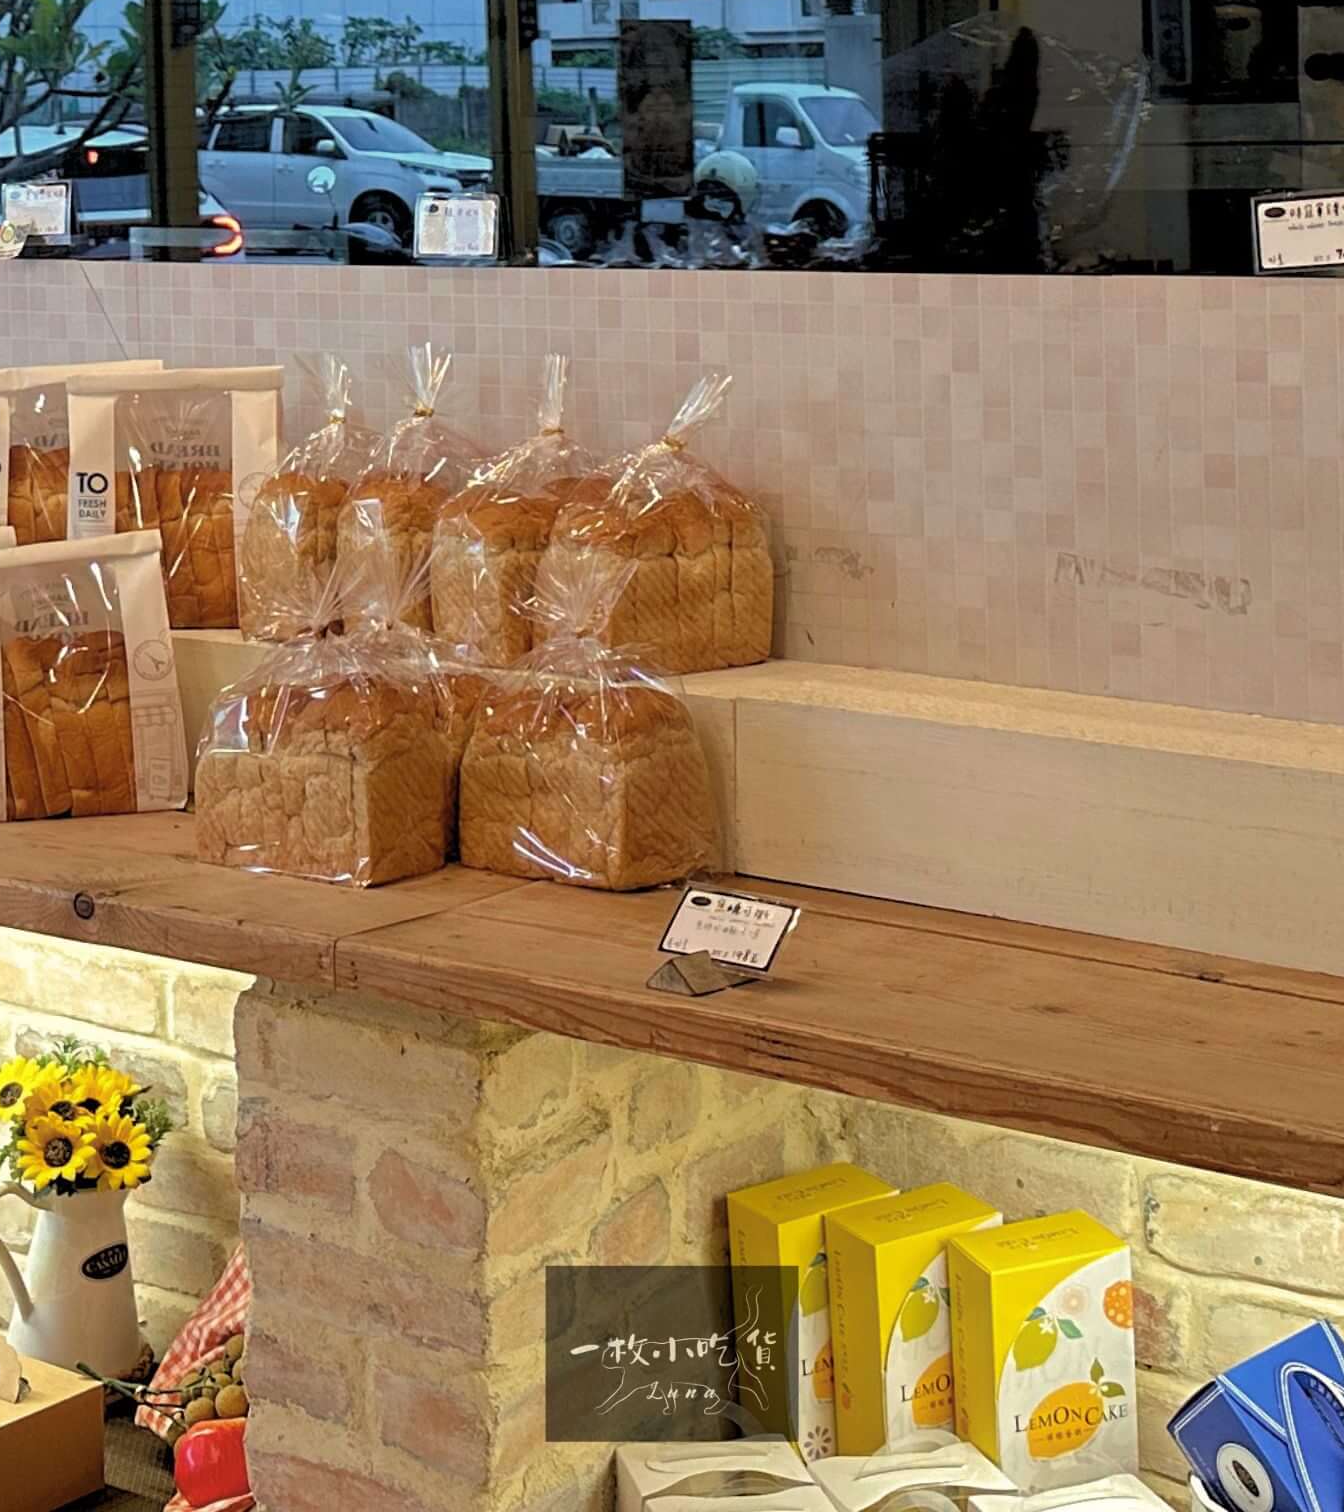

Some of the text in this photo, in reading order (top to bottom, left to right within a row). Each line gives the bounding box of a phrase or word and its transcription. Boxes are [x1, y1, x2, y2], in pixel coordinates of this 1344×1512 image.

[76, 472, 109, 495] TO
[78, 498, 107, 509] FRESH
[78, 508, 107, 520] DAILY
[1013, 1405, 1083, 1434] LEMON
[1083, 1402, 1128, 1428] CAKE
